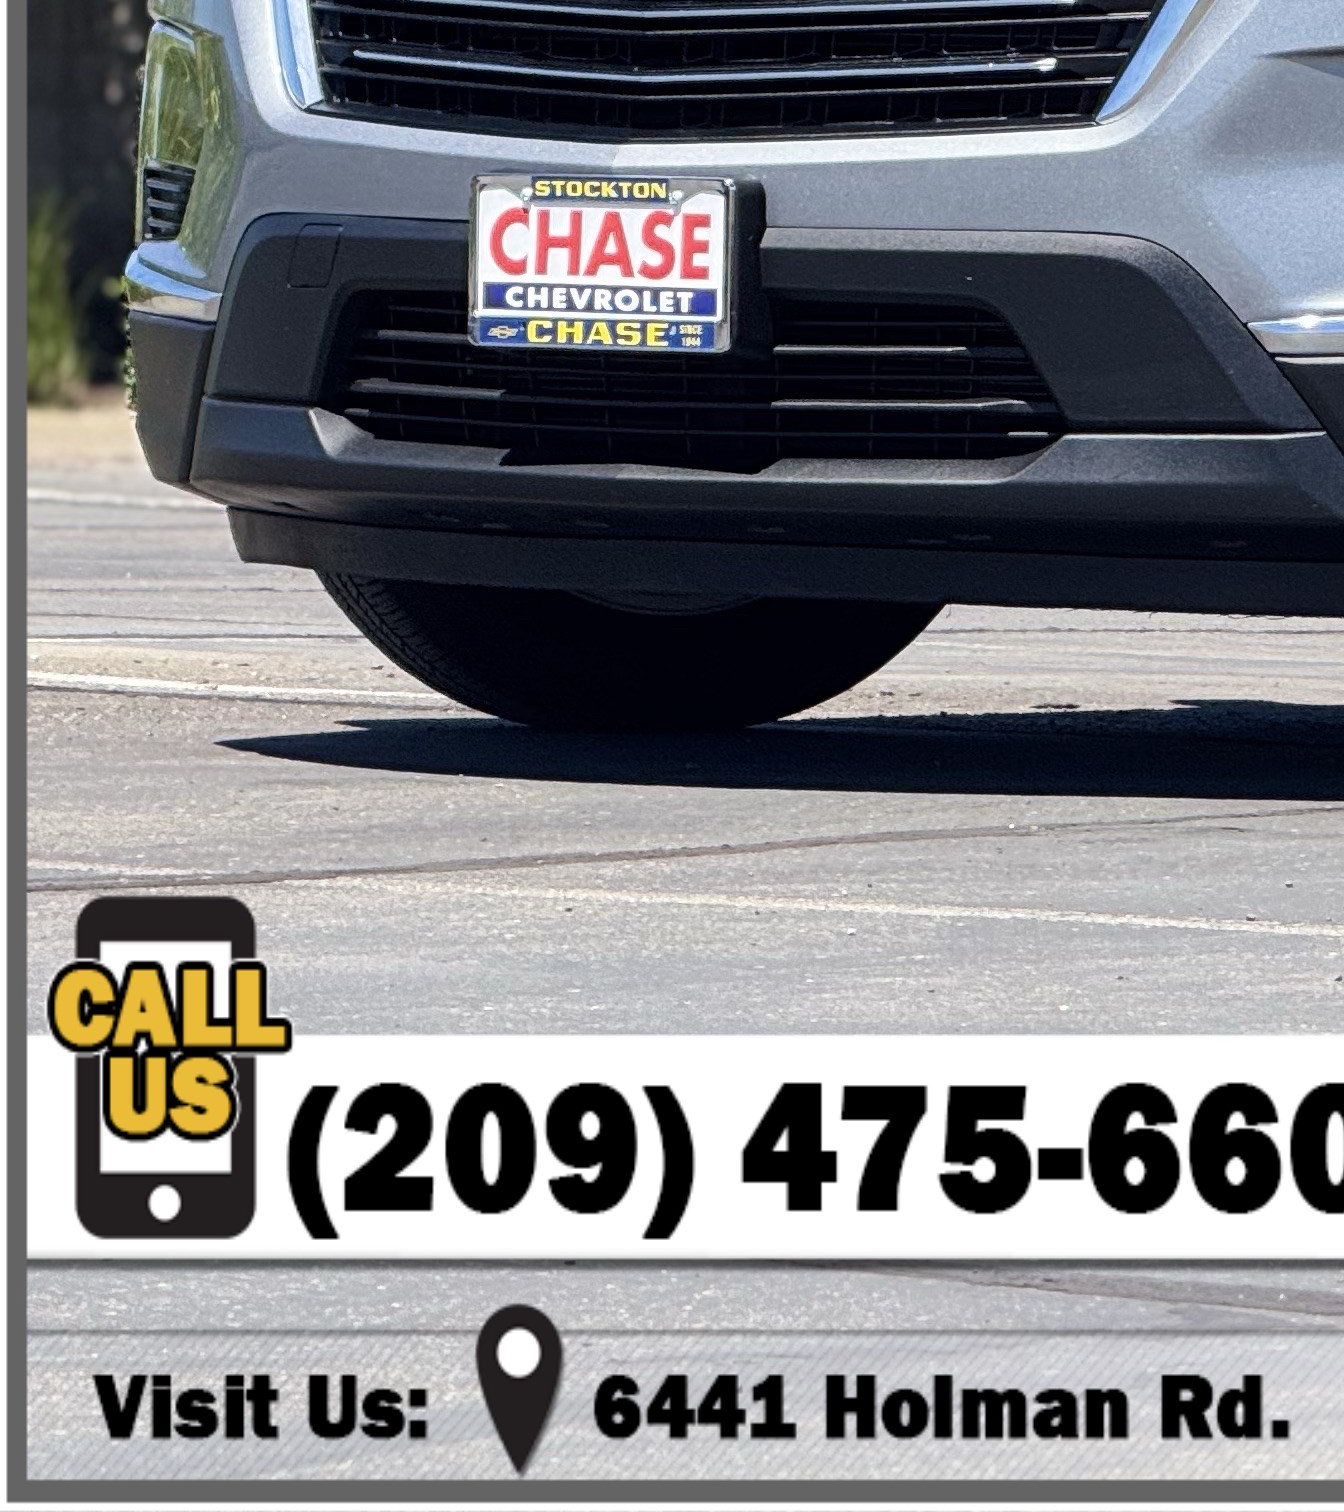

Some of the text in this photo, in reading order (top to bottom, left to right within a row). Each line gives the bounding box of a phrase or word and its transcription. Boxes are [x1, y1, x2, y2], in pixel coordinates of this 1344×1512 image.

[534, 179, 669, 200] STOCKTON
[489, 206, 712, 281] CHASE
[504, 285, 694, 314] CHEVROLET
[526, 319, 670, 347] CHASE
